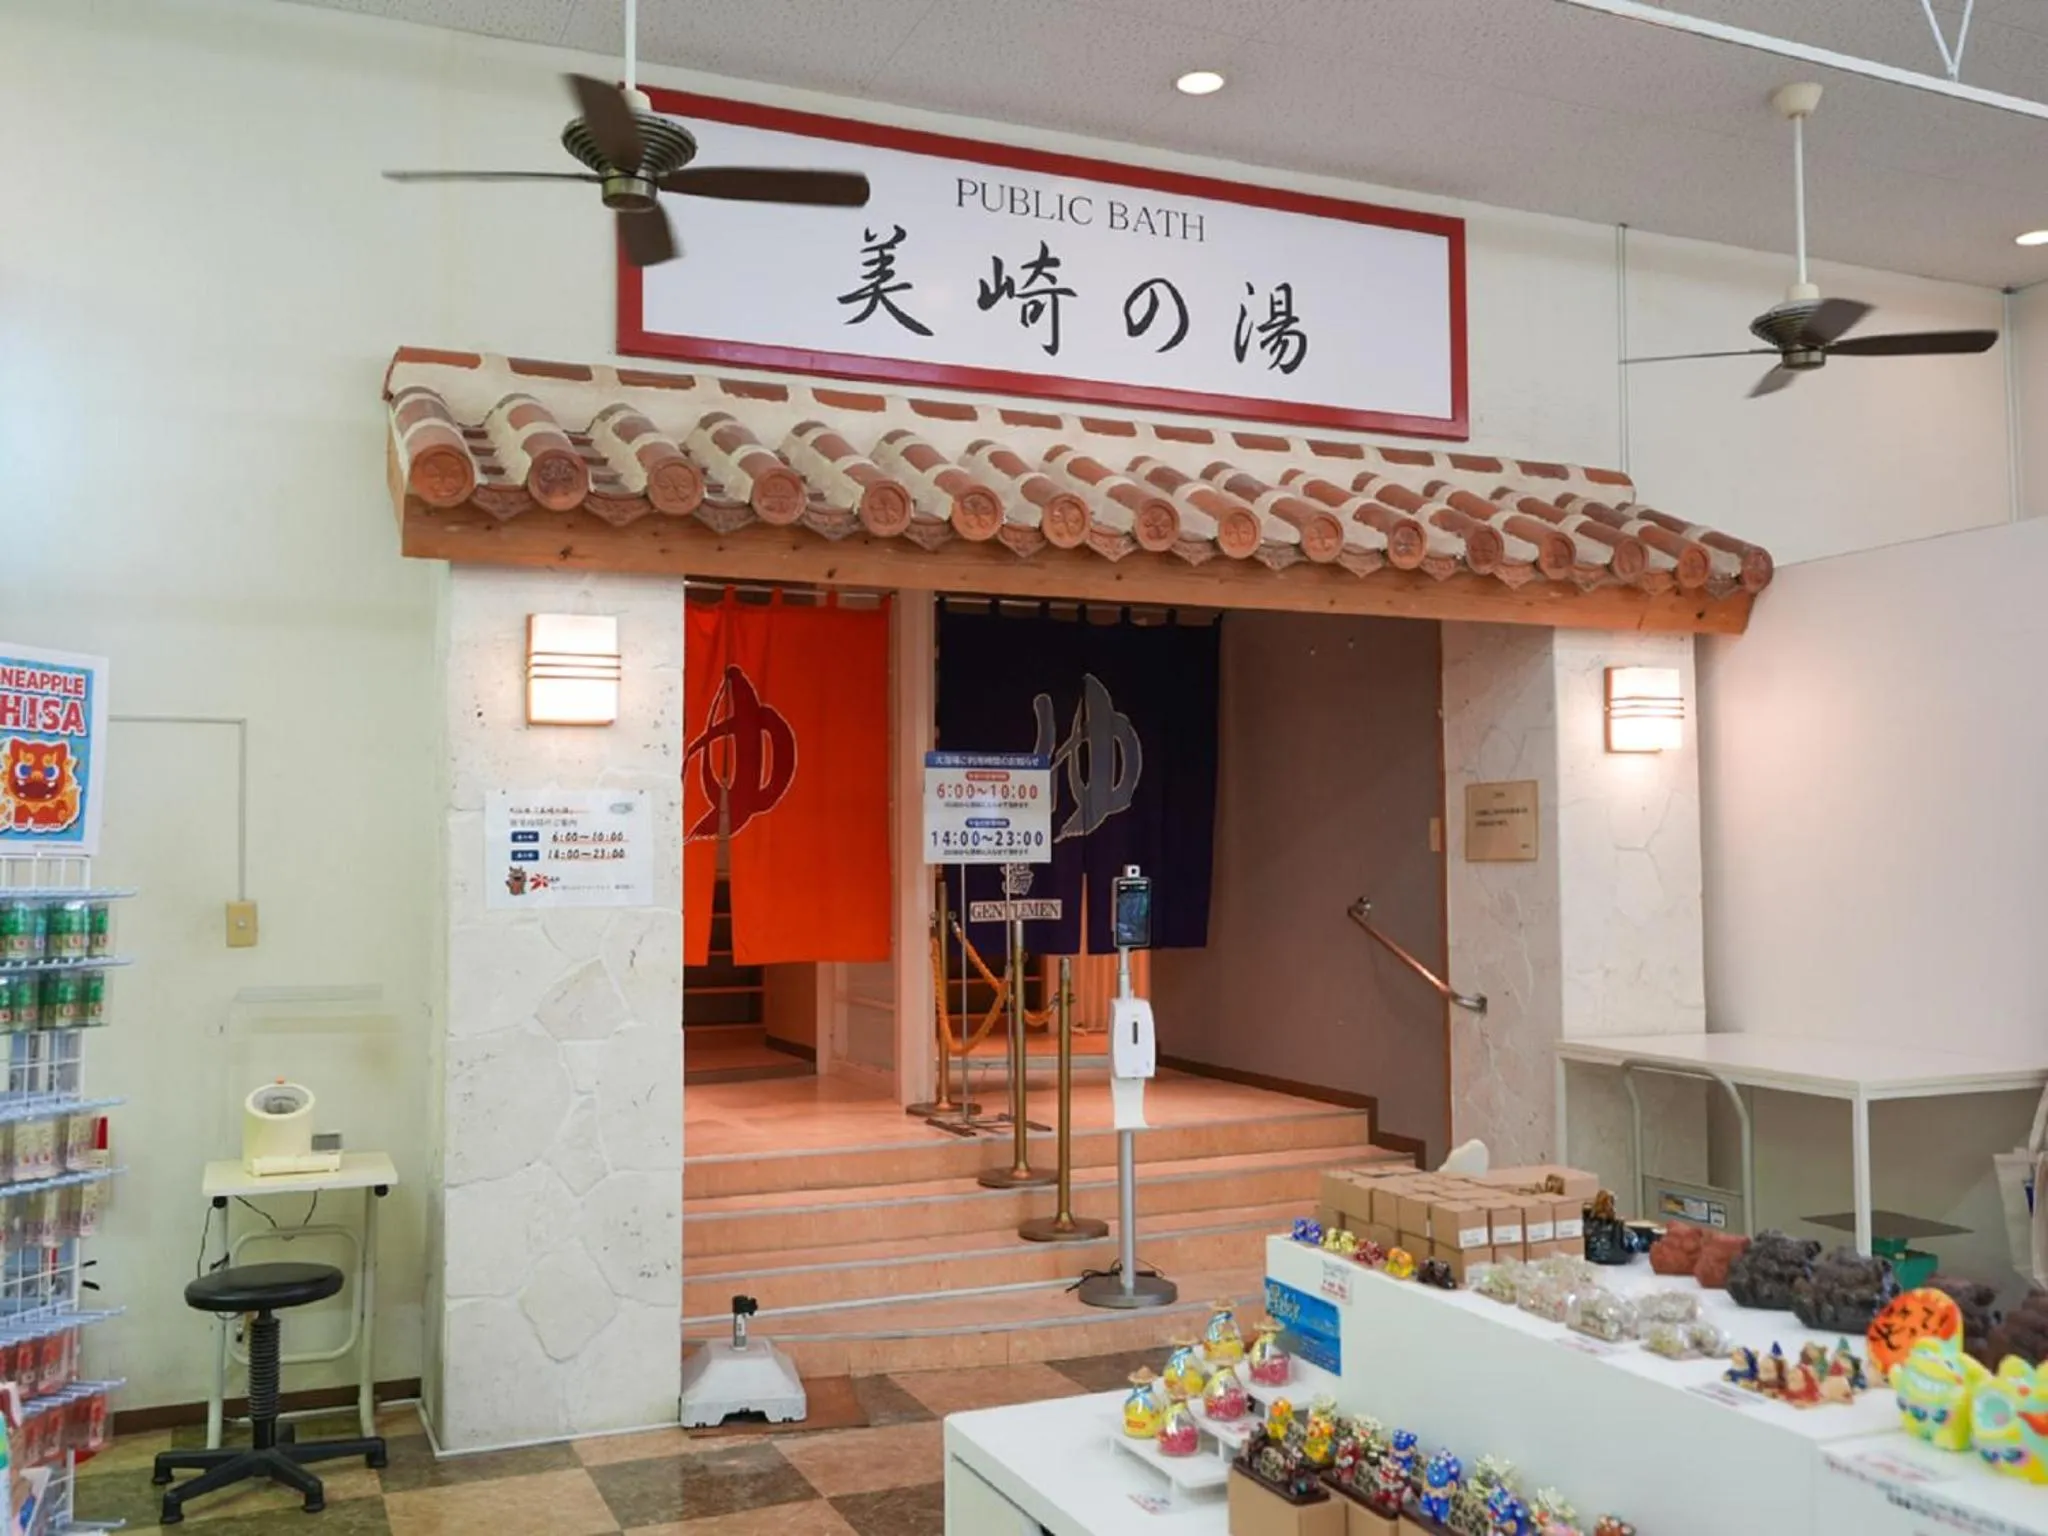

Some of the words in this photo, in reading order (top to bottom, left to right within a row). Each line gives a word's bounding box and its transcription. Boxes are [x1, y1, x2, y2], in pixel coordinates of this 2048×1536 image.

[956, 177, 1093, 226] PUBLIC
[1108, 200, 1205, 243] BATH
[837, 224, 1308, 374] 美崎の湯
[681, 664, 798, 844] ゆ
[1033, 672, 1143, 844] ゆ
